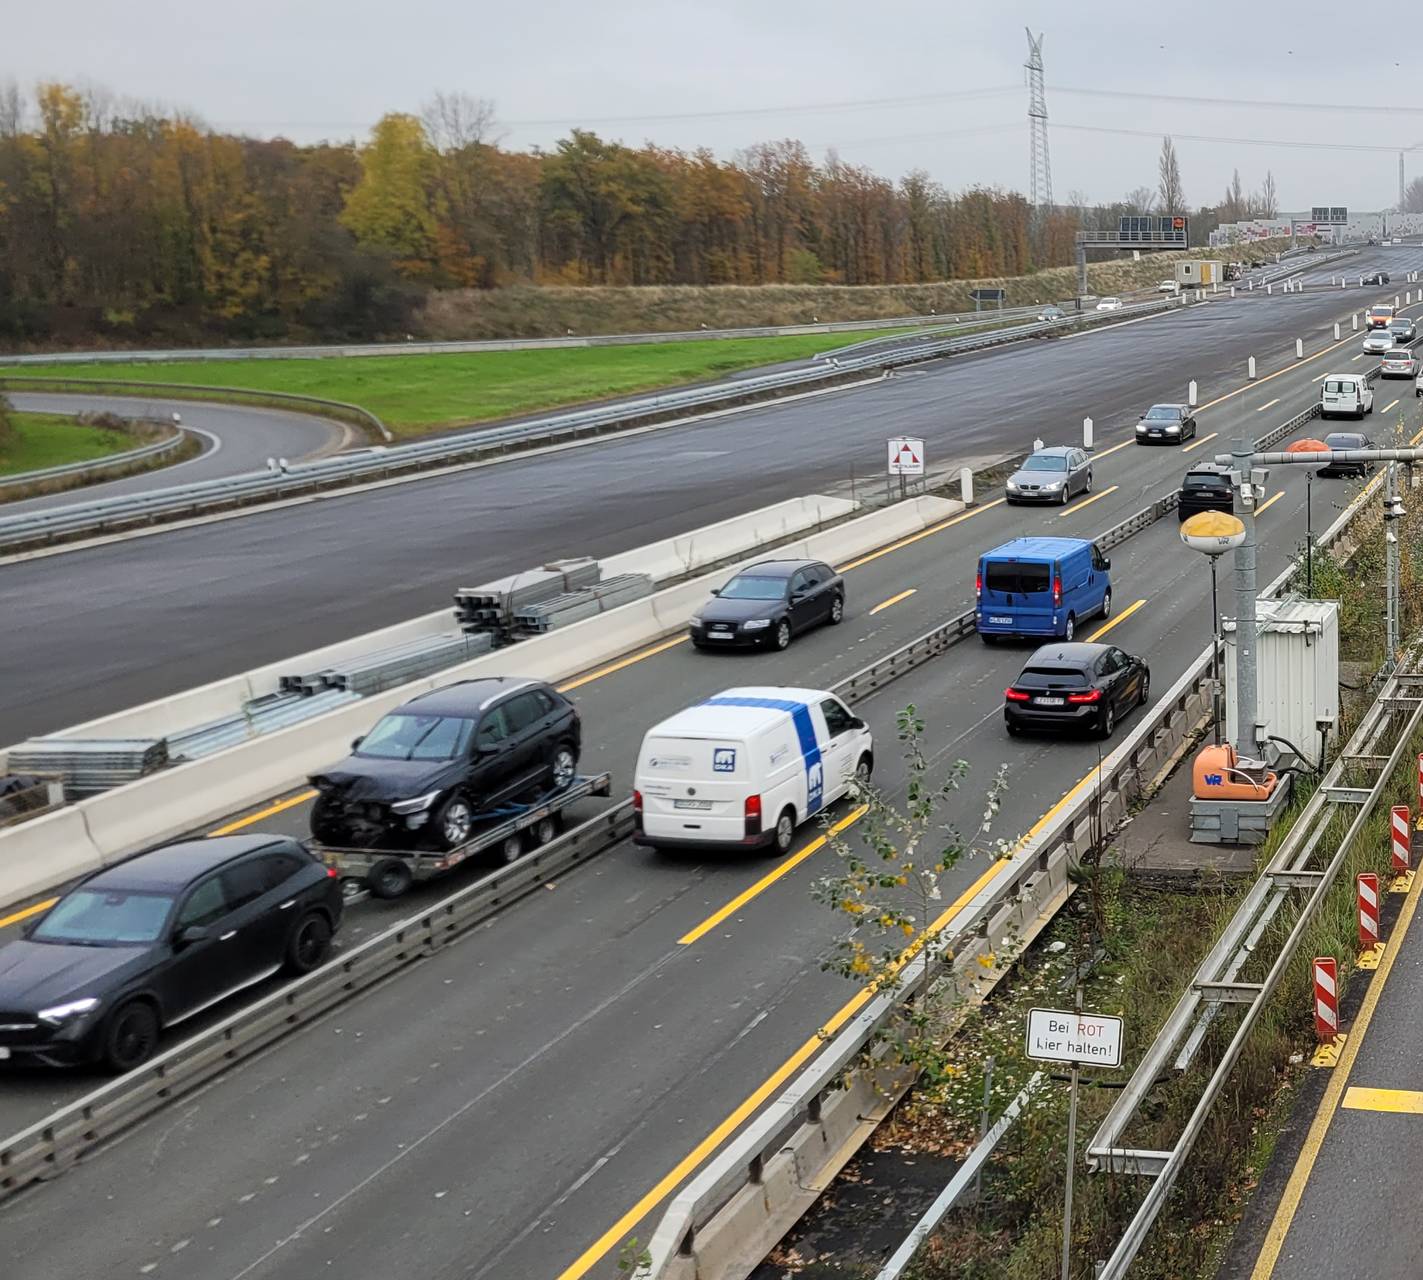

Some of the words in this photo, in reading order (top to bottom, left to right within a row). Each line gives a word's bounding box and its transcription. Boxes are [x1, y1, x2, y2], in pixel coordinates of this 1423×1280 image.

[1203, 773, 1224, 786] VR
[1049, 1020, 1070, 1034] Bei
[1077, 1023, 1105, 1037] ROT
[1067, 1040, 1113, 1057] halten!
